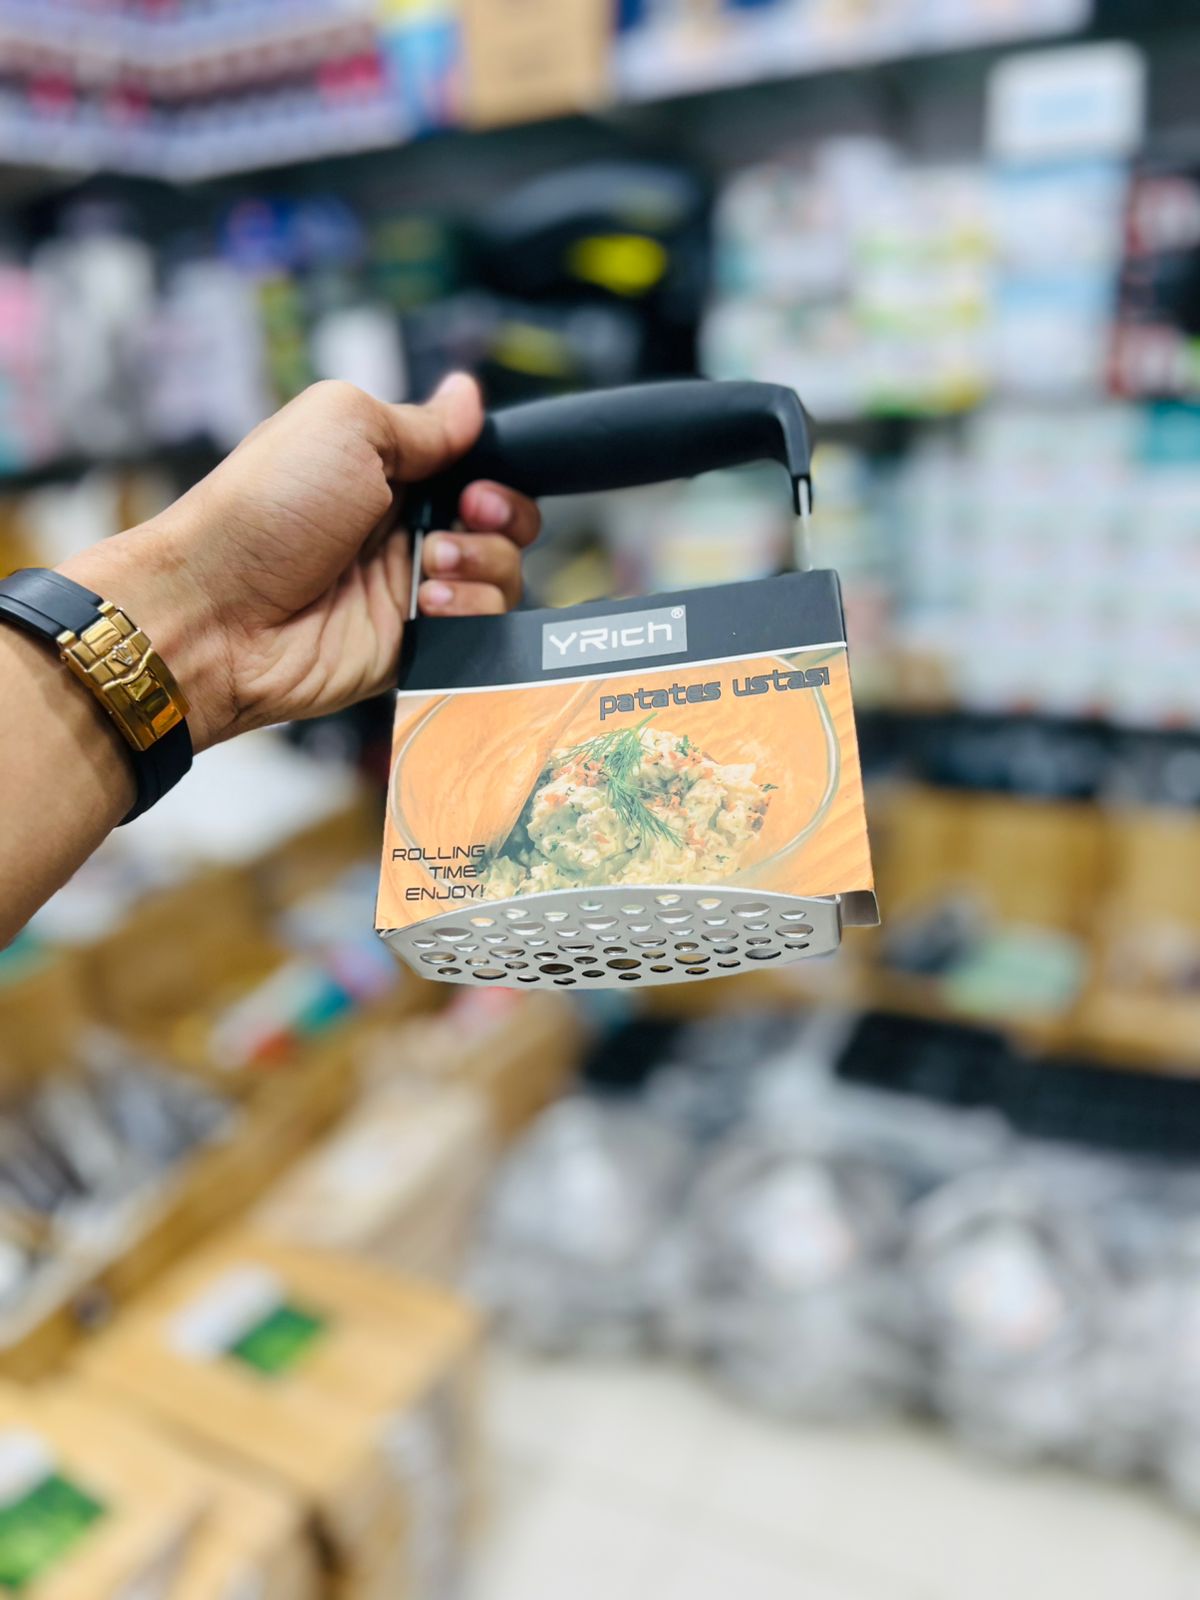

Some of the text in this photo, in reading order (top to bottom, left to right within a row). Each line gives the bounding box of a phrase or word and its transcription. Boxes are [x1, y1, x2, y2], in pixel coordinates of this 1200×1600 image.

[600, 683, 721, 720] patates
[392, 845, 486, 861] ROLLING
[405, 884, 485, 901] ENJOY!
